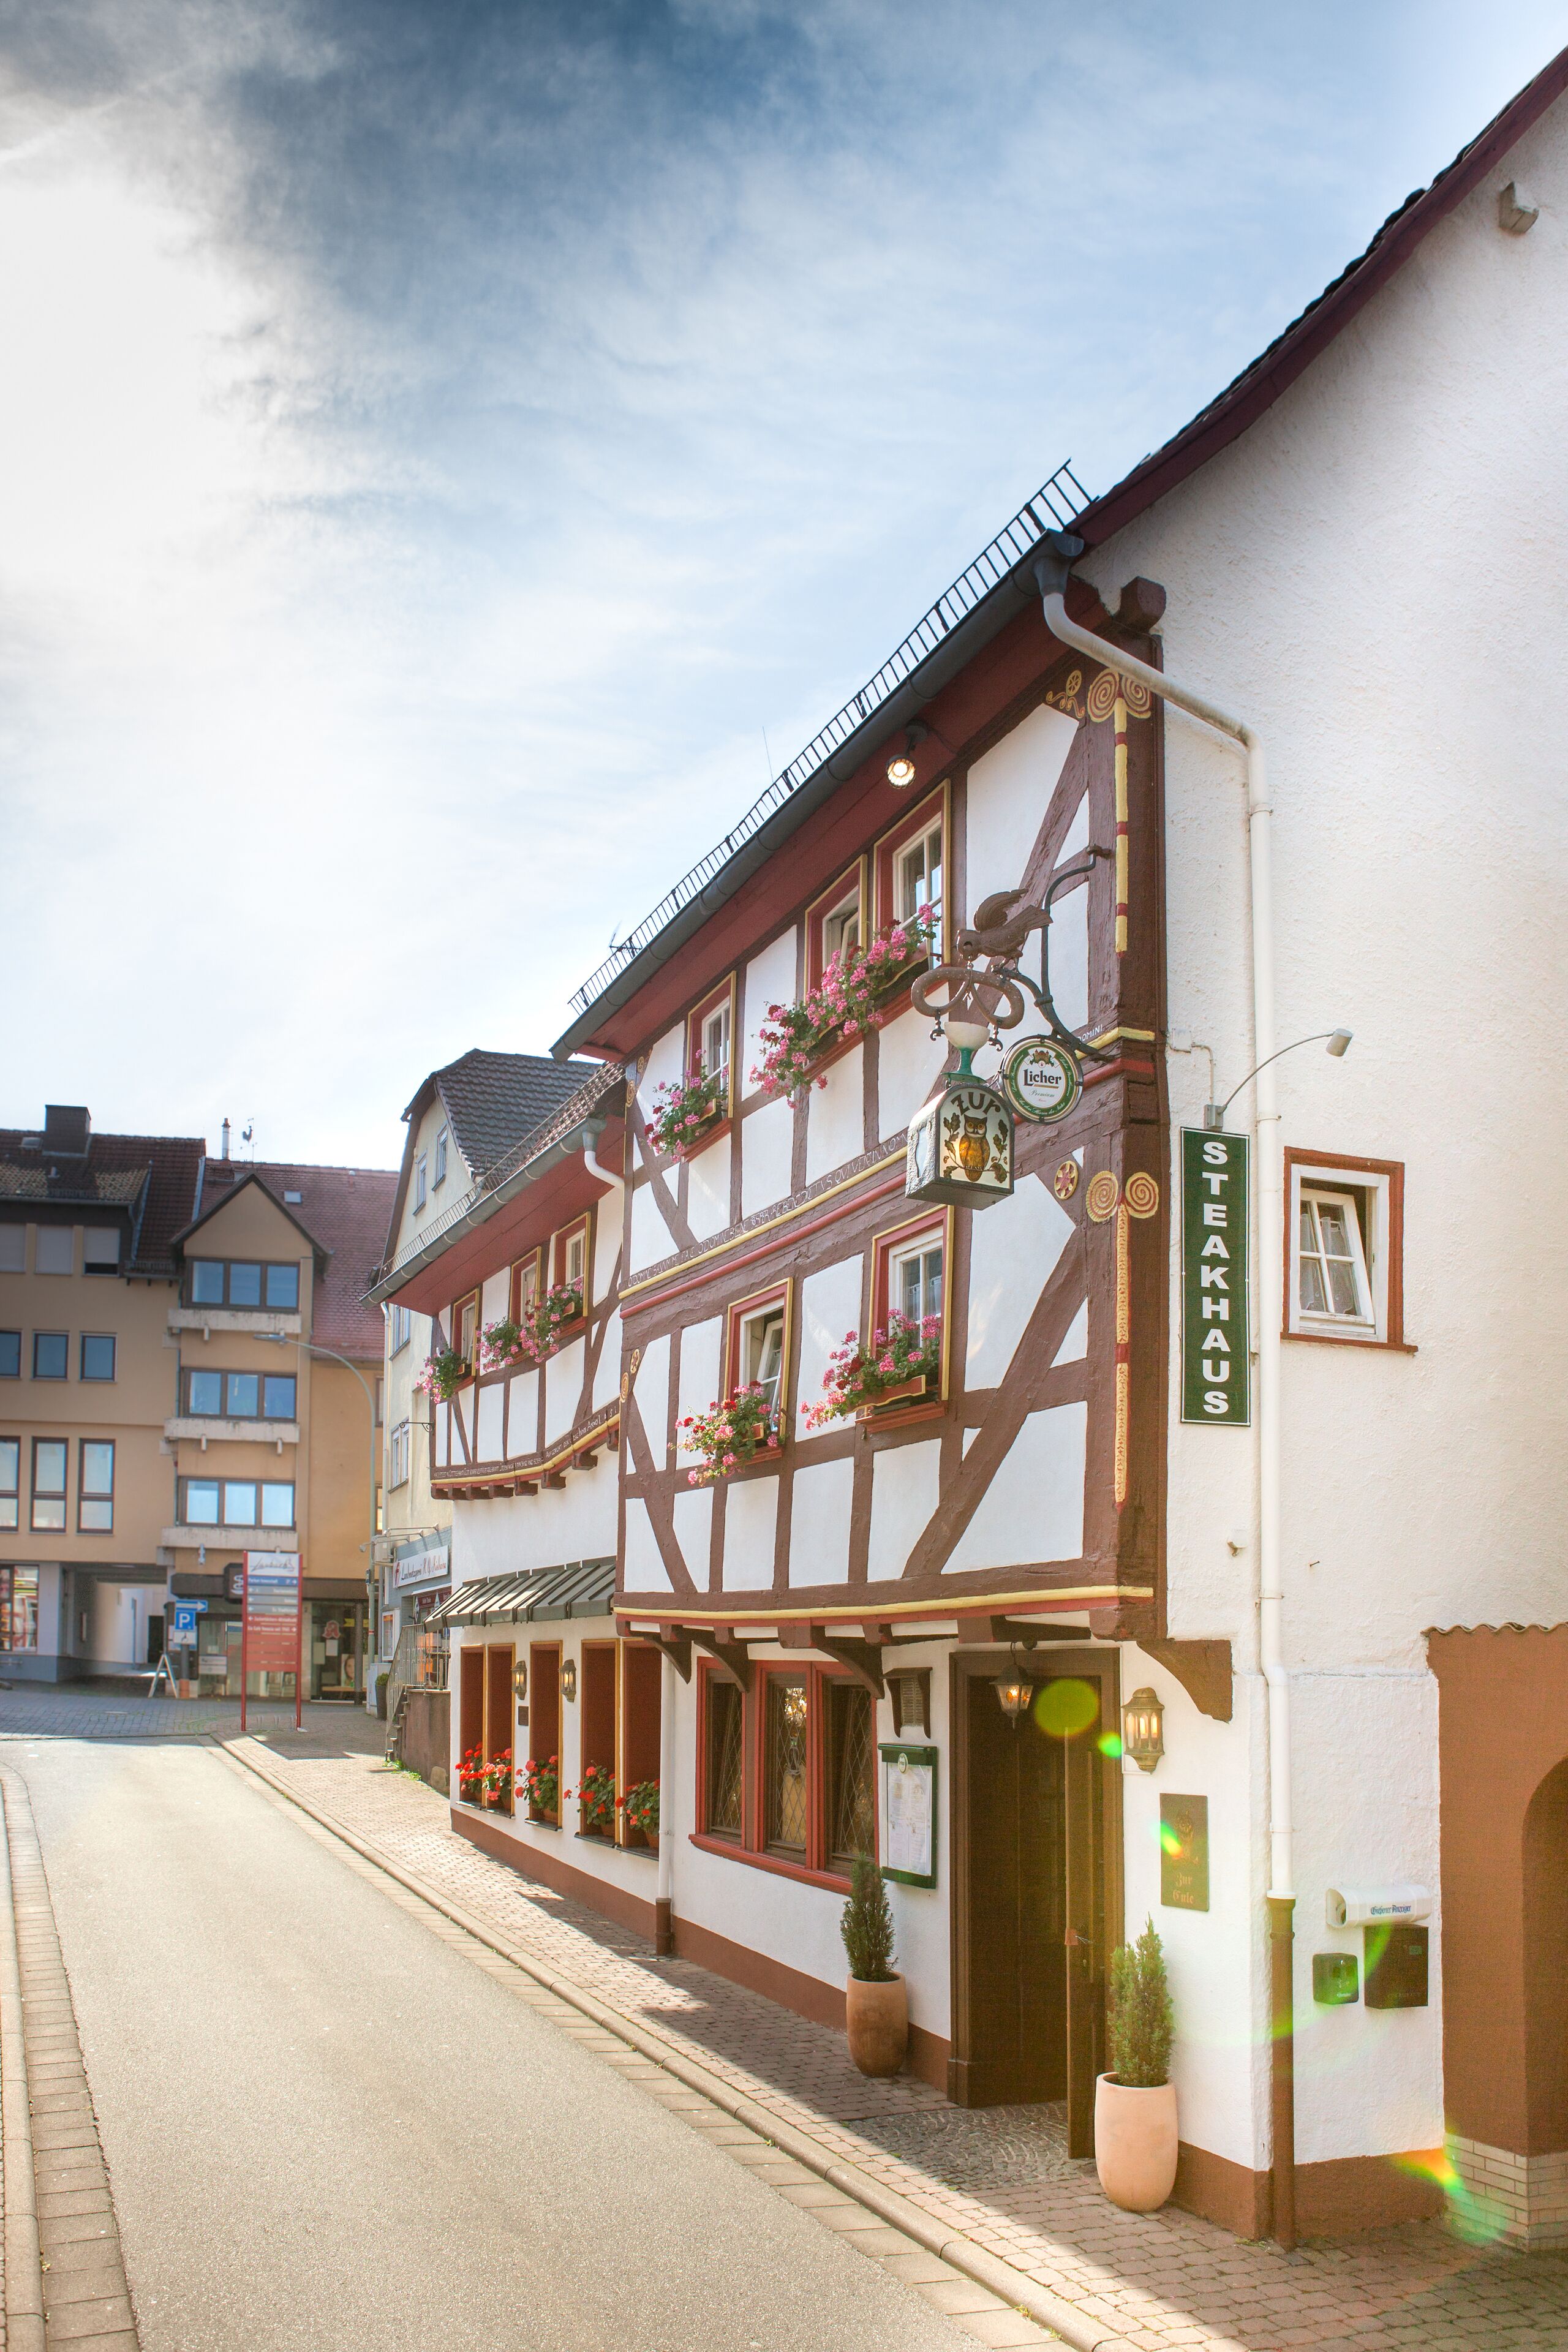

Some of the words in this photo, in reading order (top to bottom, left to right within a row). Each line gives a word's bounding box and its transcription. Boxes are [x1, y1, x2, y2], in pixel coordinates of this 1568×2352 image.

[1023, 1069, 1062, 1087] Licher
[1202, 1141, 1229, 1414] STEAKHAUS
[179, 1613, 190, 1629] P
[1175, 1871, 1193, 1887] Zur
